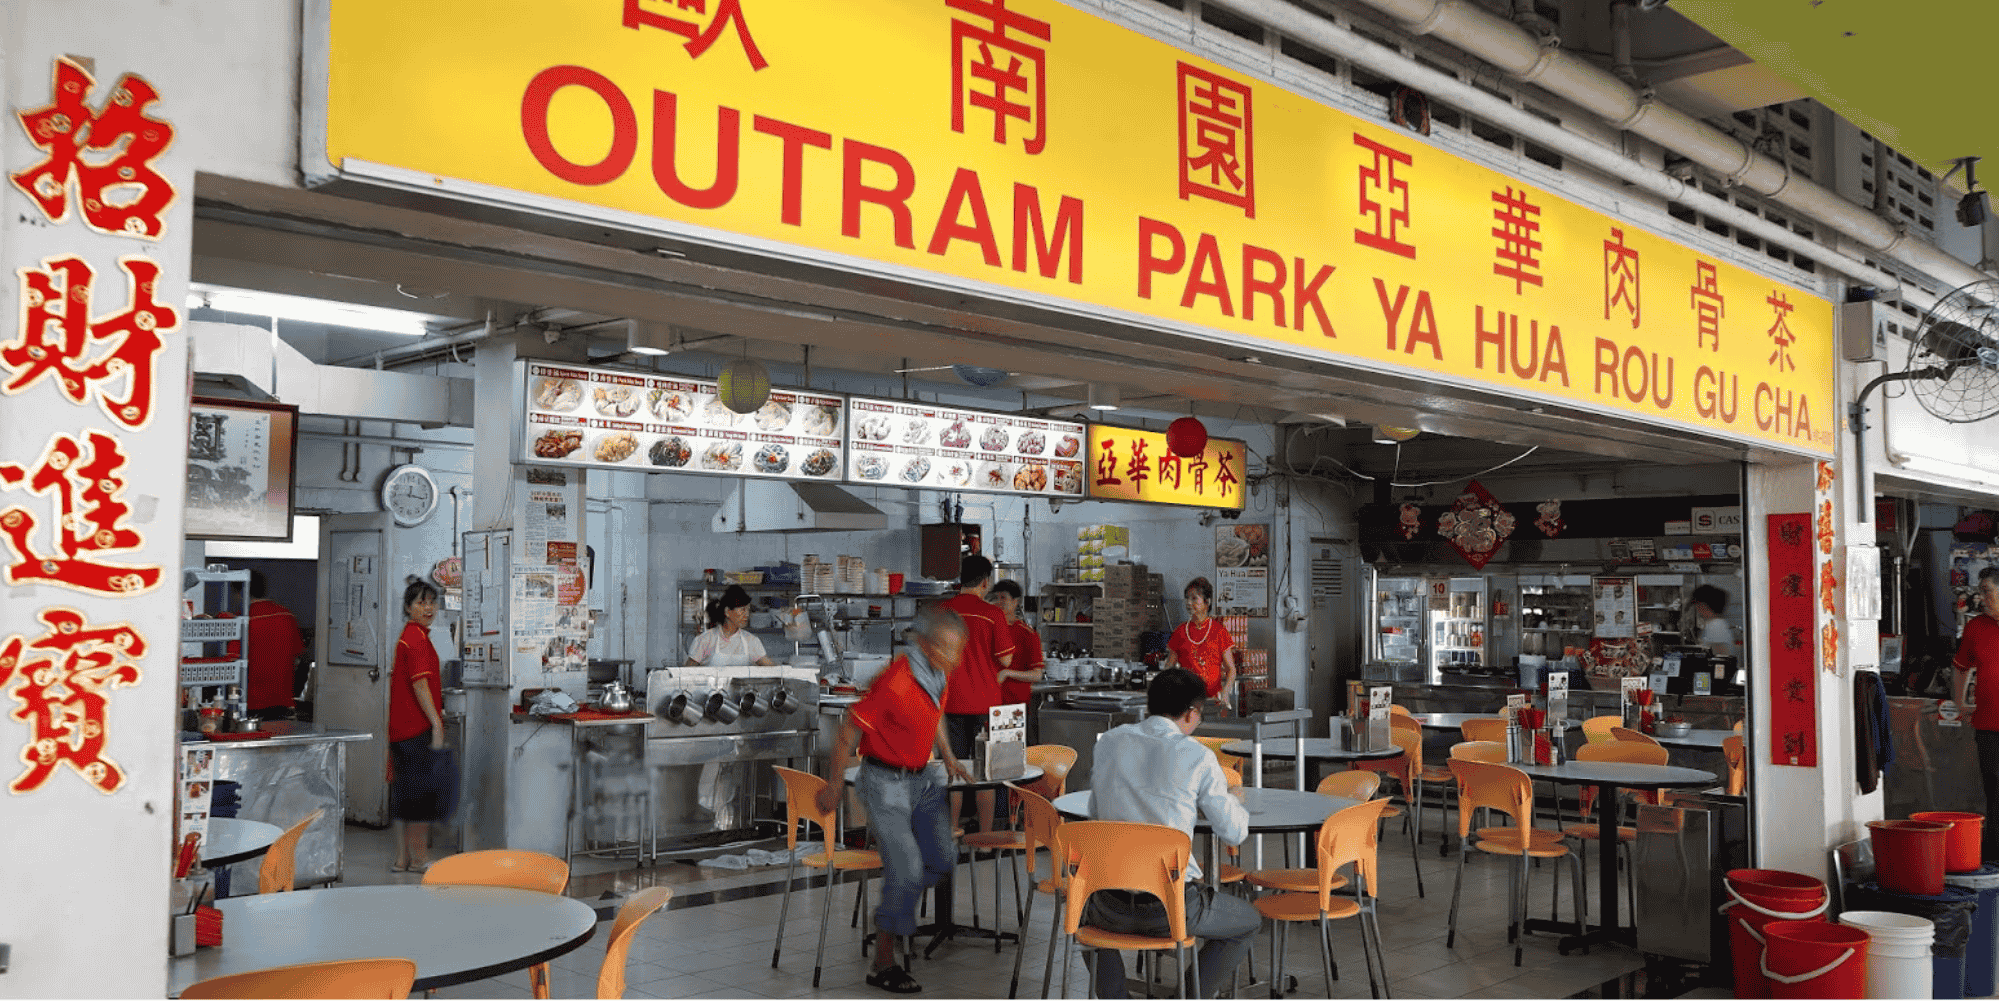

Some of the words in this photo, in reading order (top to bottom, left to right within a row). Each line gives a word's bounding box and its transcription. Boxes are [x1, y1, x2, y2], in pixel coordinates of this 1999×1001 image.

[520, 64, 1084, 285] OUTRAM
[1137, 214, 1338, 340] PARK
[1372, 276, 1444, 361] YA
[1474, 304, 1570, 388] HUA
[1594, 336, 1674, 410] ROU
[1693, 364, 1738, 424] GU
[1754, 381, 1812, 442] CHA
[1432, 582, 1445, 595] 10
